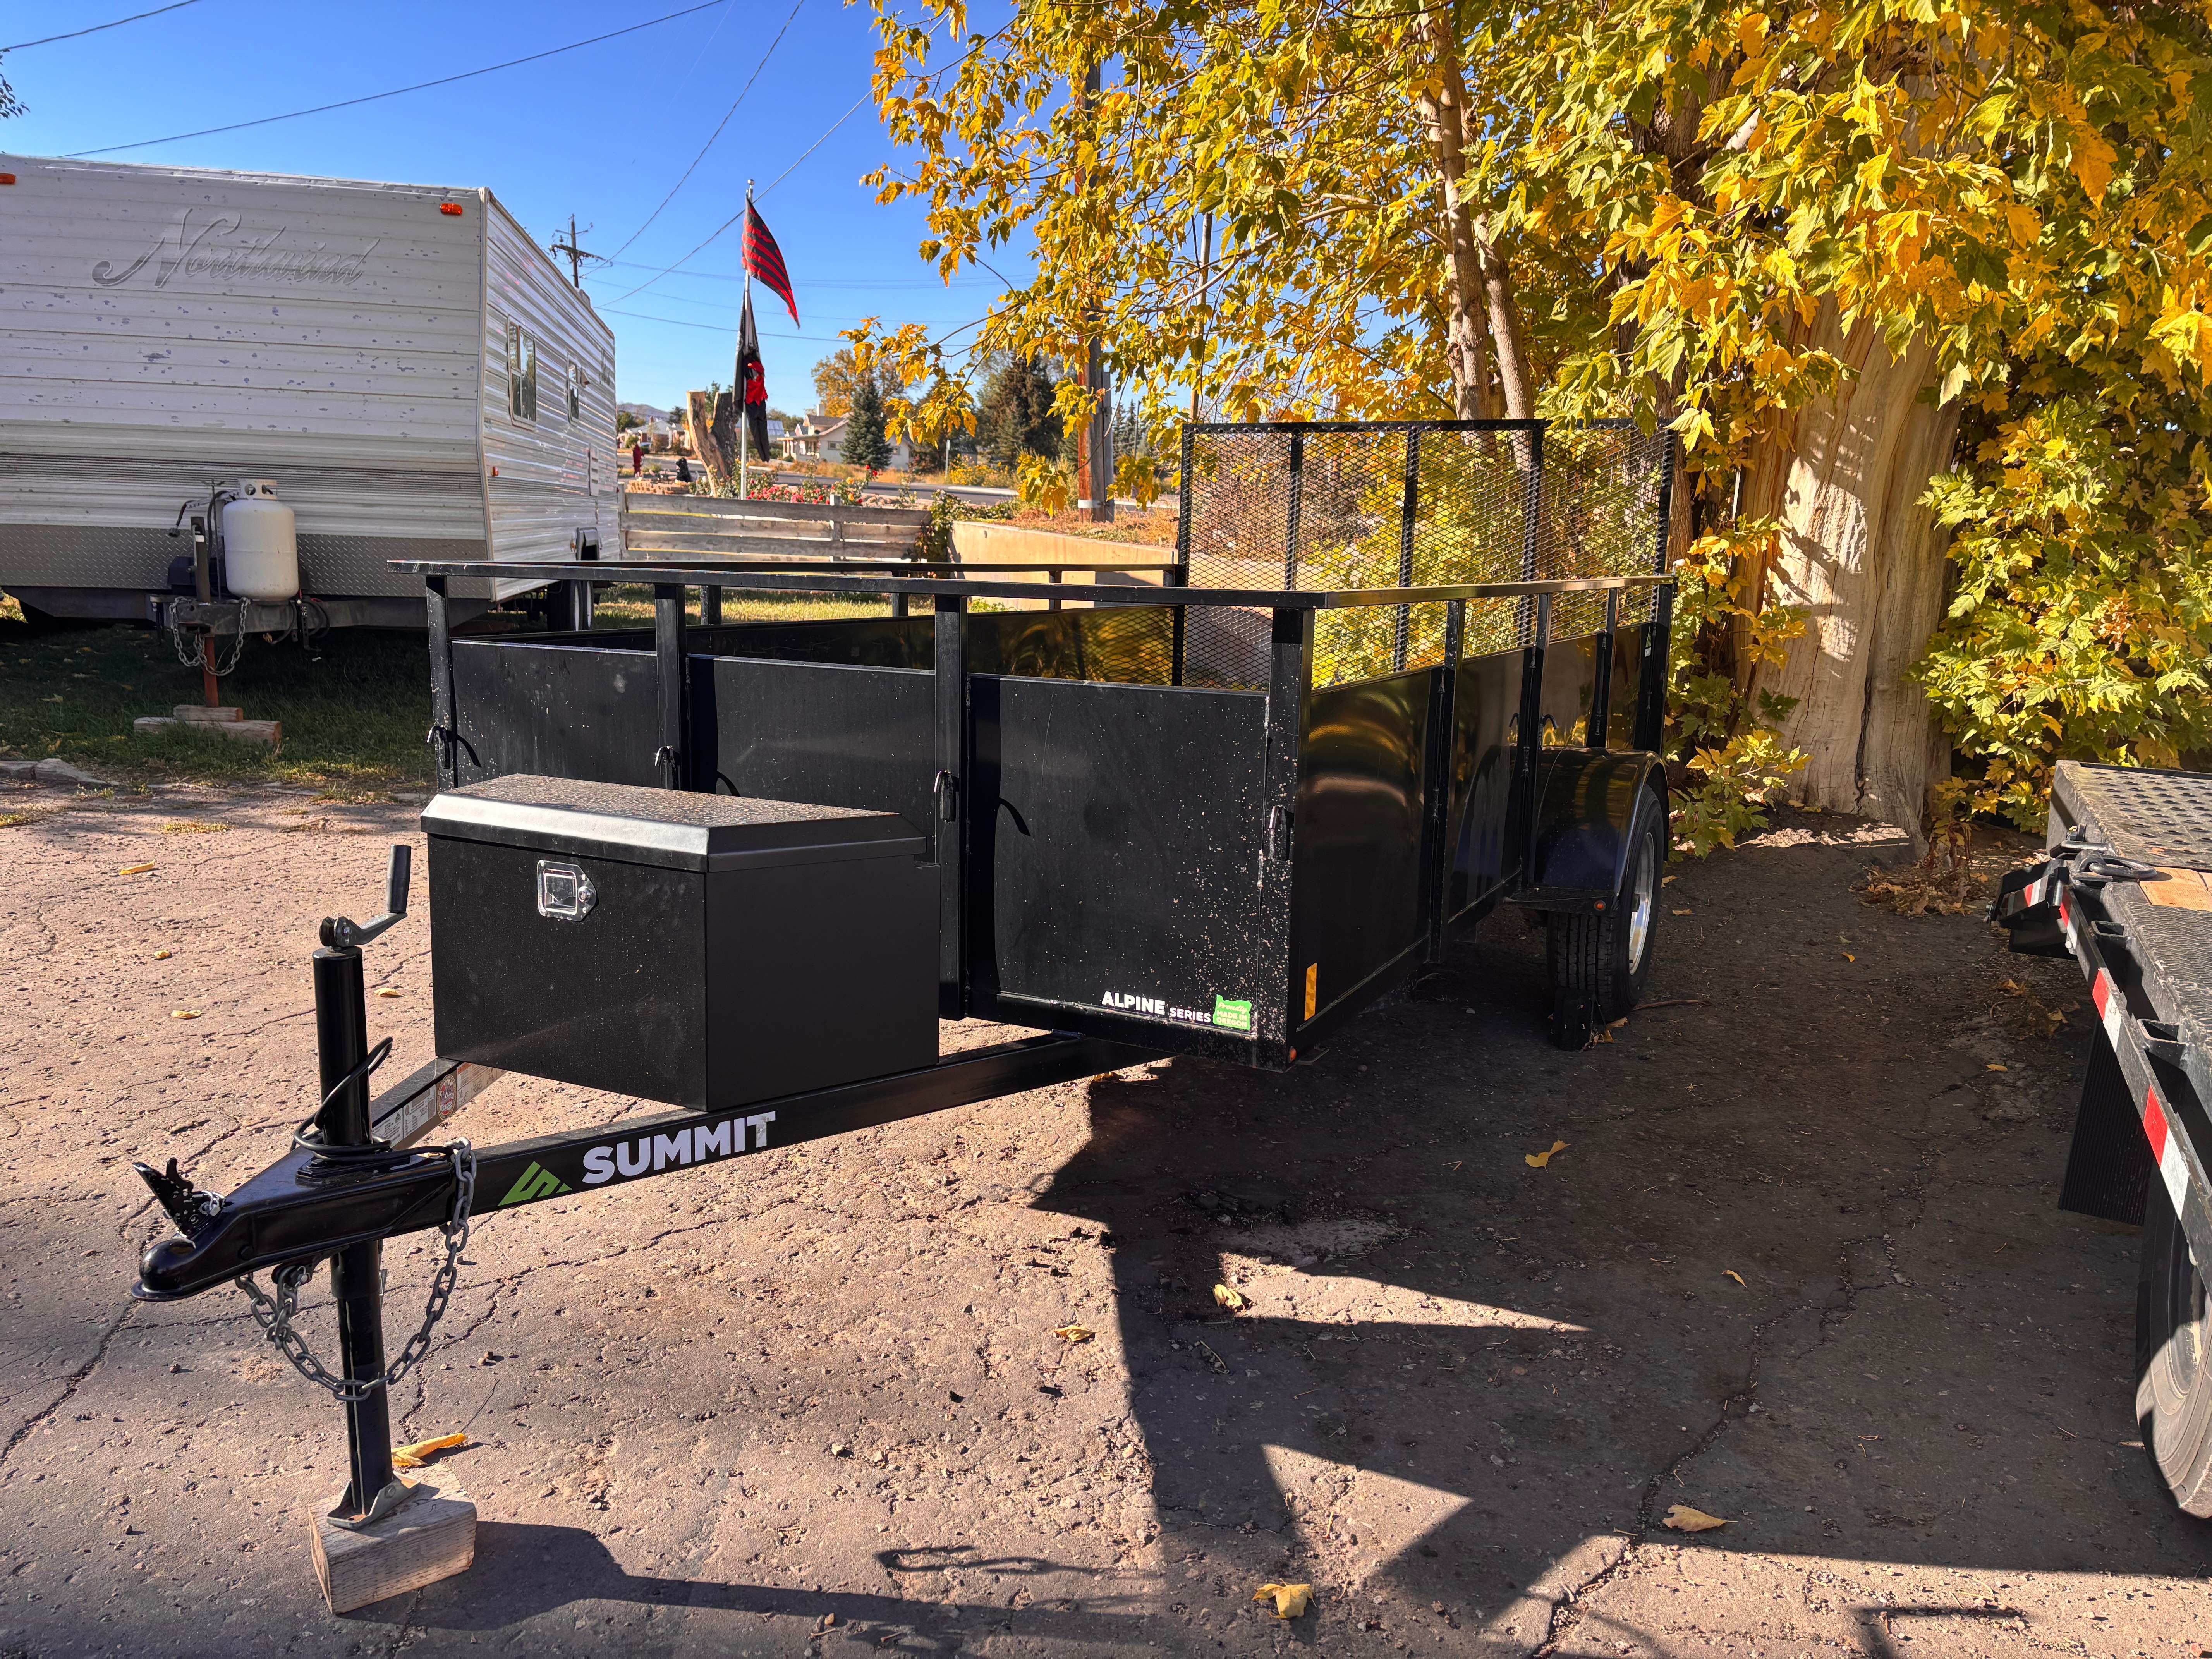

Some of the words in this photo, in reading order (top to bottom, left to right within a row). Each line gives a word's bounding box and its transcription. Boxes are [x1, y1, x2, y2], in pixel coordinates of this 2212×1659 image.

[91, 208, 381, 288] Northwind
[1101, 991, 1165, 1015] ALPINE
[1170, 1007, 1211, 1023] SERIES
[1216, 1010, 1238, 1019] MADE
[1218, 1002, 1247, 1014] Proudly
[1216, 1017, 1247, 1028] OREGON
[582, 1111, 776, 1184] SUMMIT
